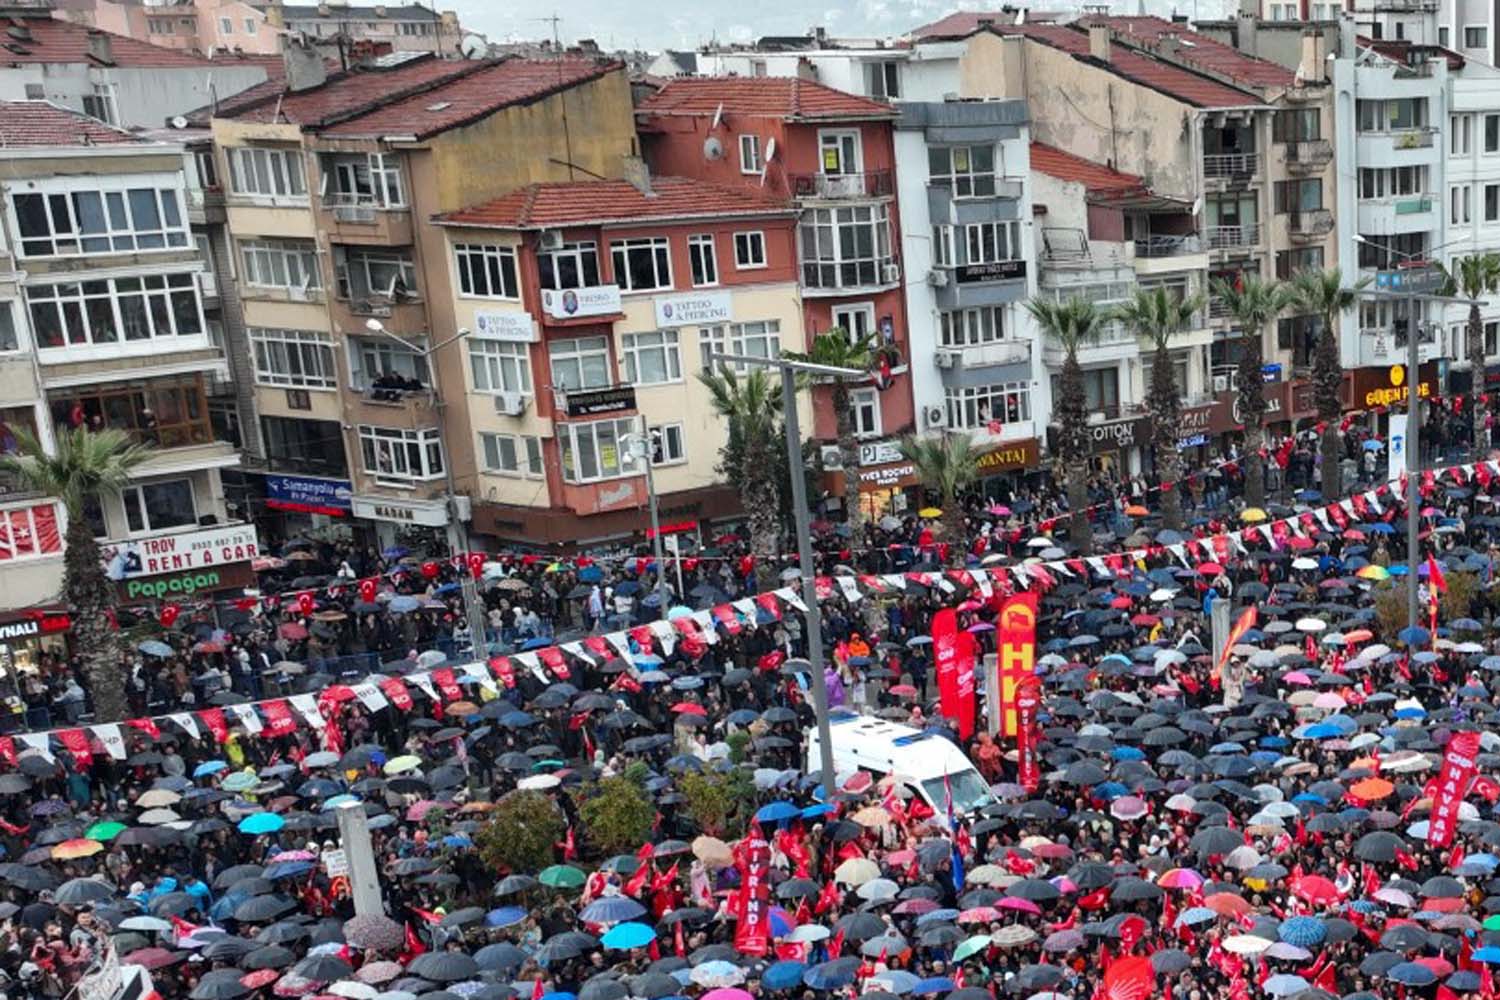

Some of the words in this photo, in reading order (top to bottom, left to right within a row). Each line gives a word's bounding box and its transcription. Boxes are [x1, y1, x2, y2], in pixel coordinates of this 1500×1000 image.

[675, 299, 712, 312] TATTOO
[1087, 423, 1135, 440] OTTON
[862, 447, 877, 462] PJ
[144, 538, 176, 555] TROY
[148, 553, 192, 572] RENT
[204, 550, 213, 563] A
[223, 544, 257, 561] CAR
[128, 572, 219, 598] Papağan
[1432, 768, 1462, 842] HAVRAN
